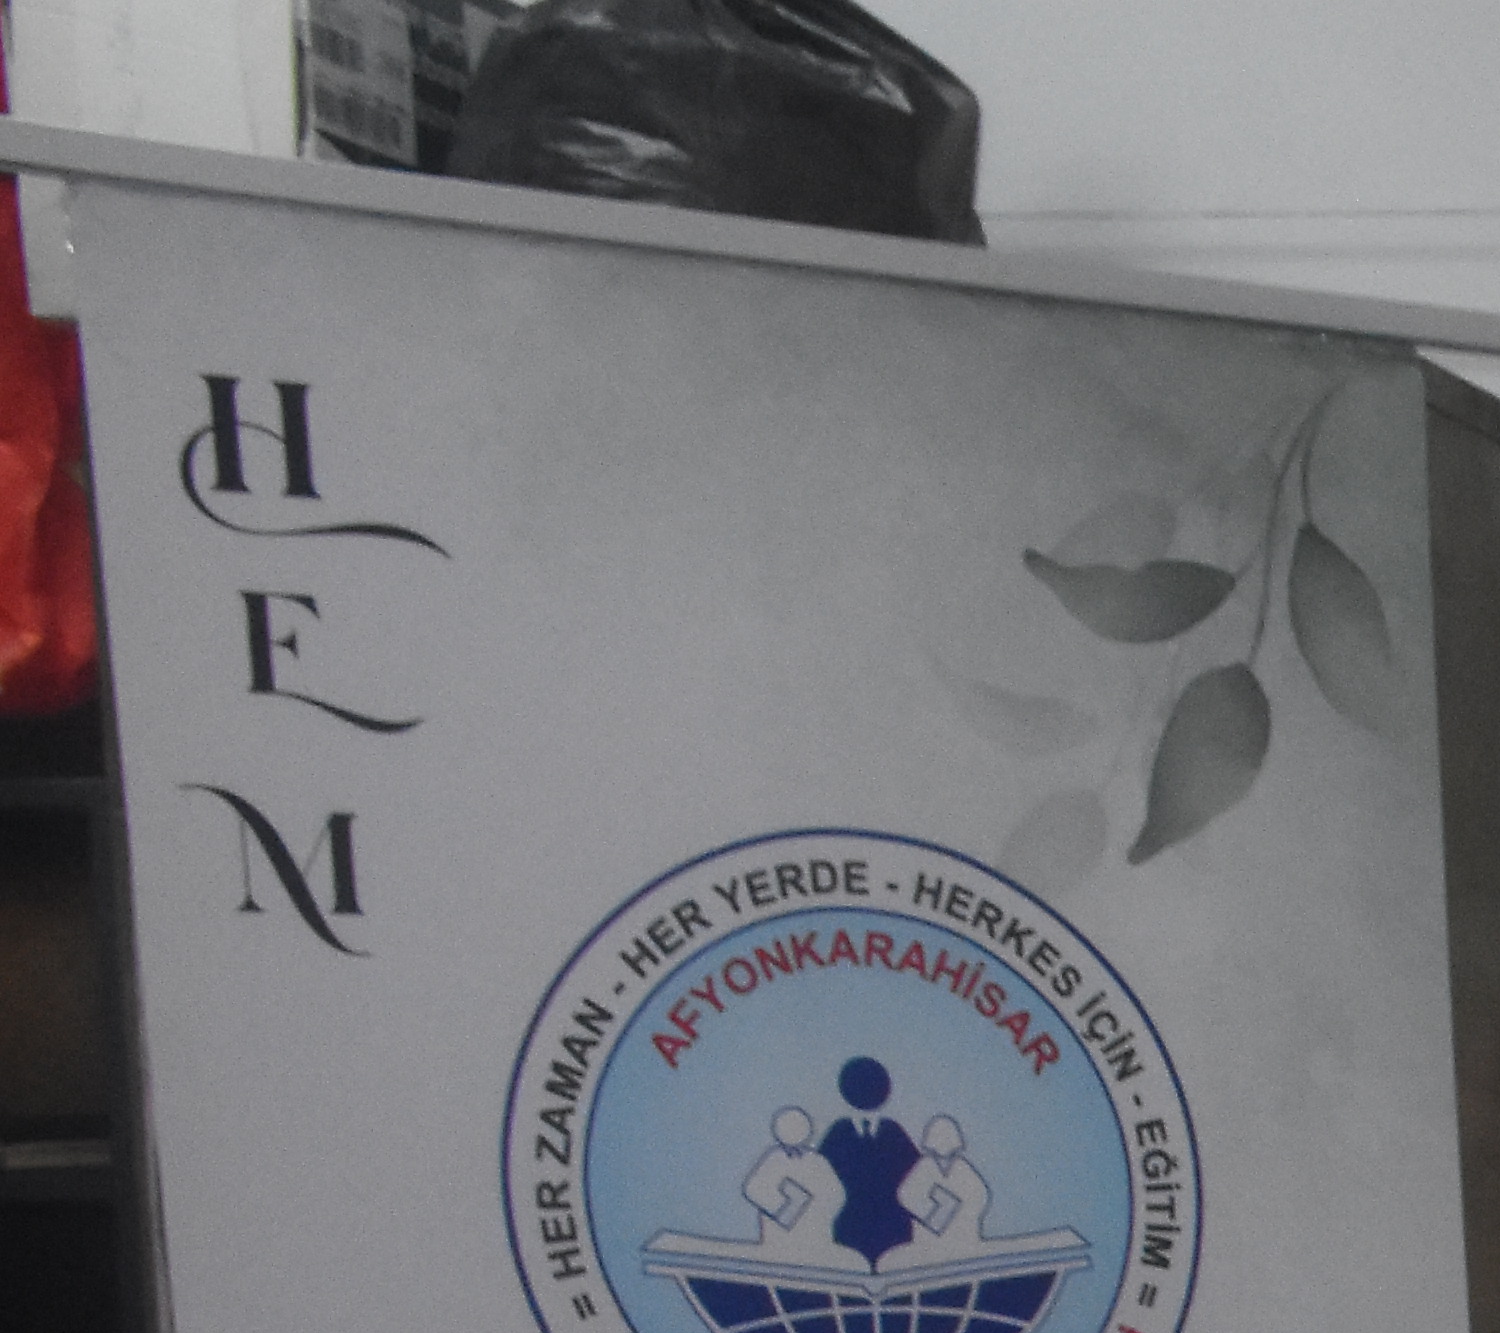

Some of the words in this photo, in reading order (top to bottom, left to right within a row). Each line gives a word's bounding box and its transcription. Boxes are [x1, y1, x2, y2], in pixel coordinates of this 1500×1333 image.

[620, 884, 716, 979] HER
[711, 858, 872, 916] YERDE
[912, 869, 1084, 1002] HERKES
[648, 928, 1064, 1077] AFYONKARAHİSAR
[1072, 988, 1147, 1080] İÇİN
[535, 995, 619, 1163] ZAMAN
[534, 1180, 589, 1284] HER
[1131, 1117, 1184, 1275] EĞİTİM
